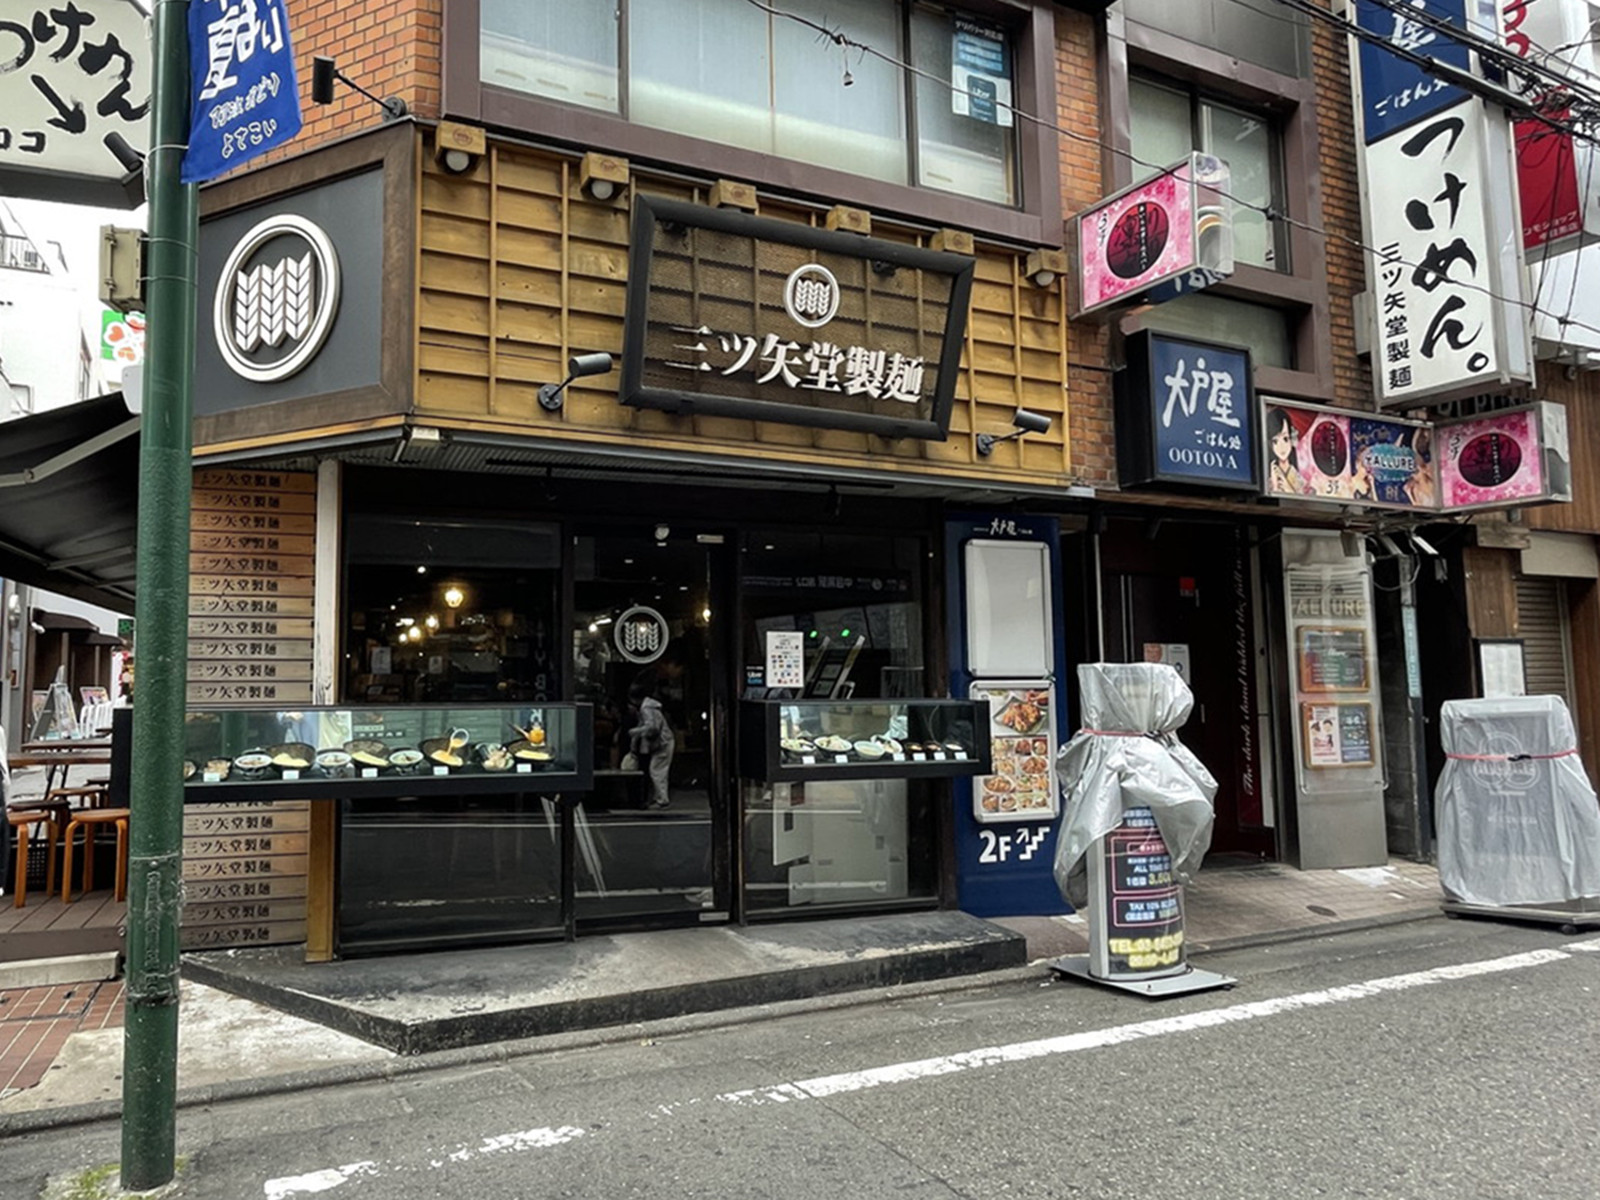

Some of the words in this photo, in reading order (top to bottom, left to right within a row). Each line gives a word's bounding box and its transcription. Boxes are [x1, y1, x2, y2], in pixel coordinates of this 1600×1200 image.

[221, 118, 278, 158] よさこい
[1380, 242, 1412, 391] 三ツ矢堂製麺
[664, 325, 925, 403] 三ツ矢堂製麺
[1162, 357, 1241, 428] 大戸屋
[1194, 429, 1242, 450] ごはん処
[1168, 447, 1238, 469] OOTOYA
[1373, 455, 1415, 470] ALLURE
[199, 493, 281, 509] 三ツ矢堂製麺
[197, 514, 280, 530] 三ツ矢堂製麺
[195, 535, 279, 550] 三ツ矢堂製麺
[195, 556, 279, 572] 三ツ矢堂製麺
[193, 577, 278, 592] 三ツ矢堂製麺
[193, 599, 278, 614] 三ツ矢堂製麺
[1296, 597, 1366, 617] ALLURE
[192, 621, 277, 635] 三ツ矢堂製麺
[192, 642, 276, 656] 三ツ矢堂製麺
[192, 663, 276, 678] 三ツ矢堂製麺
[191, 685, 275, 699] 三ツ矢堂製麺
[186, 816, 273, 831] 三ツ矢堂製麺
[186, 838, 272, 853] 三ツ矢堂製麺
[979, 829, 1012, 863] 2F
[185, 860, 271, 876] 三ツ矢堂製麺
[186, 883, 271, 899] 三ツ矢堂製麺
[185, 905, 270, 921] 三ツ矢堂製麺
